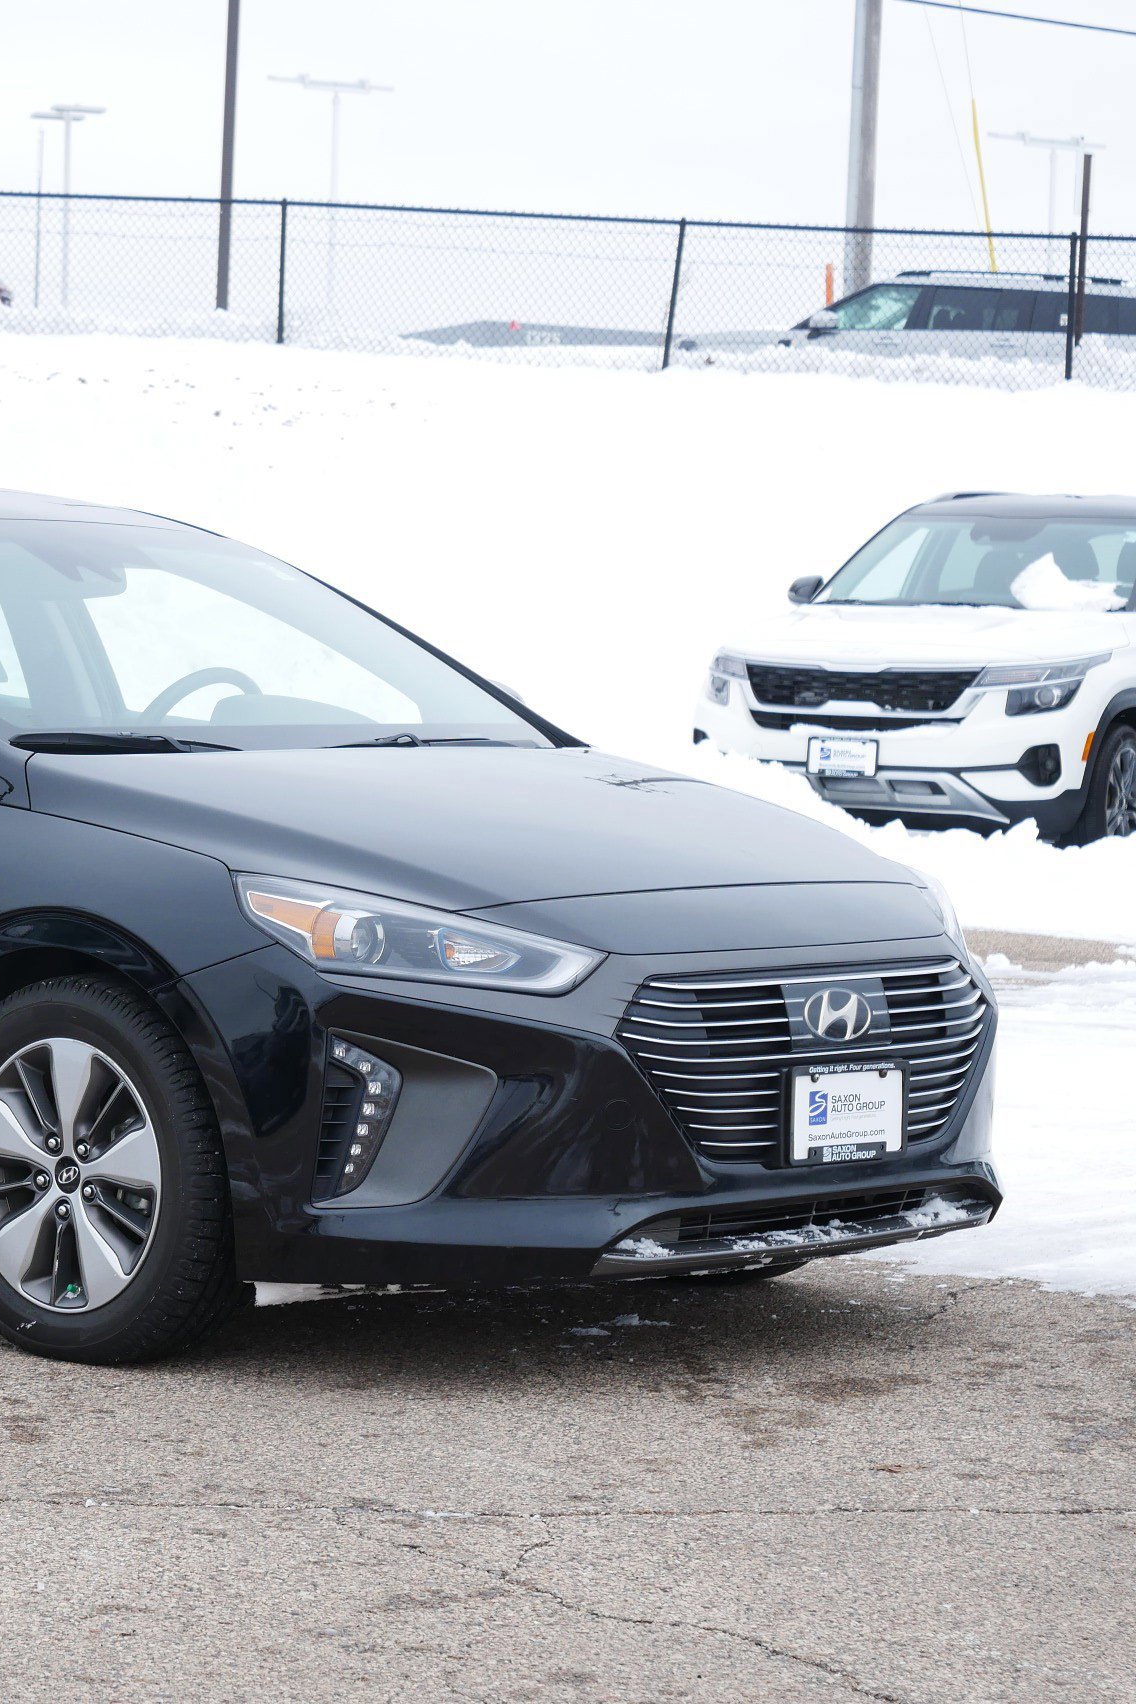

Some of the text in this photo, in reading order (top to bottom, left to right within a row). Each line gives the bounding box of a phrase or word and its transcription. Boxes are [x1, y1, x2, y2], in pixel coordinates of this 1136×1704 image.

[809, 1066, 829, 1074] Getting
[862, 1062, 896, 1071] generations.
[831, 1094, 861, 1104] SAXON
[830, 1100, 886, 1113] AUTO GROUP
[808, 1129, 886, 1142] SaxonAutoGroup.com
[832, 1145, 857, 1154] SAXON
[832, 1150, 876, 1162] AUTO GROUP
